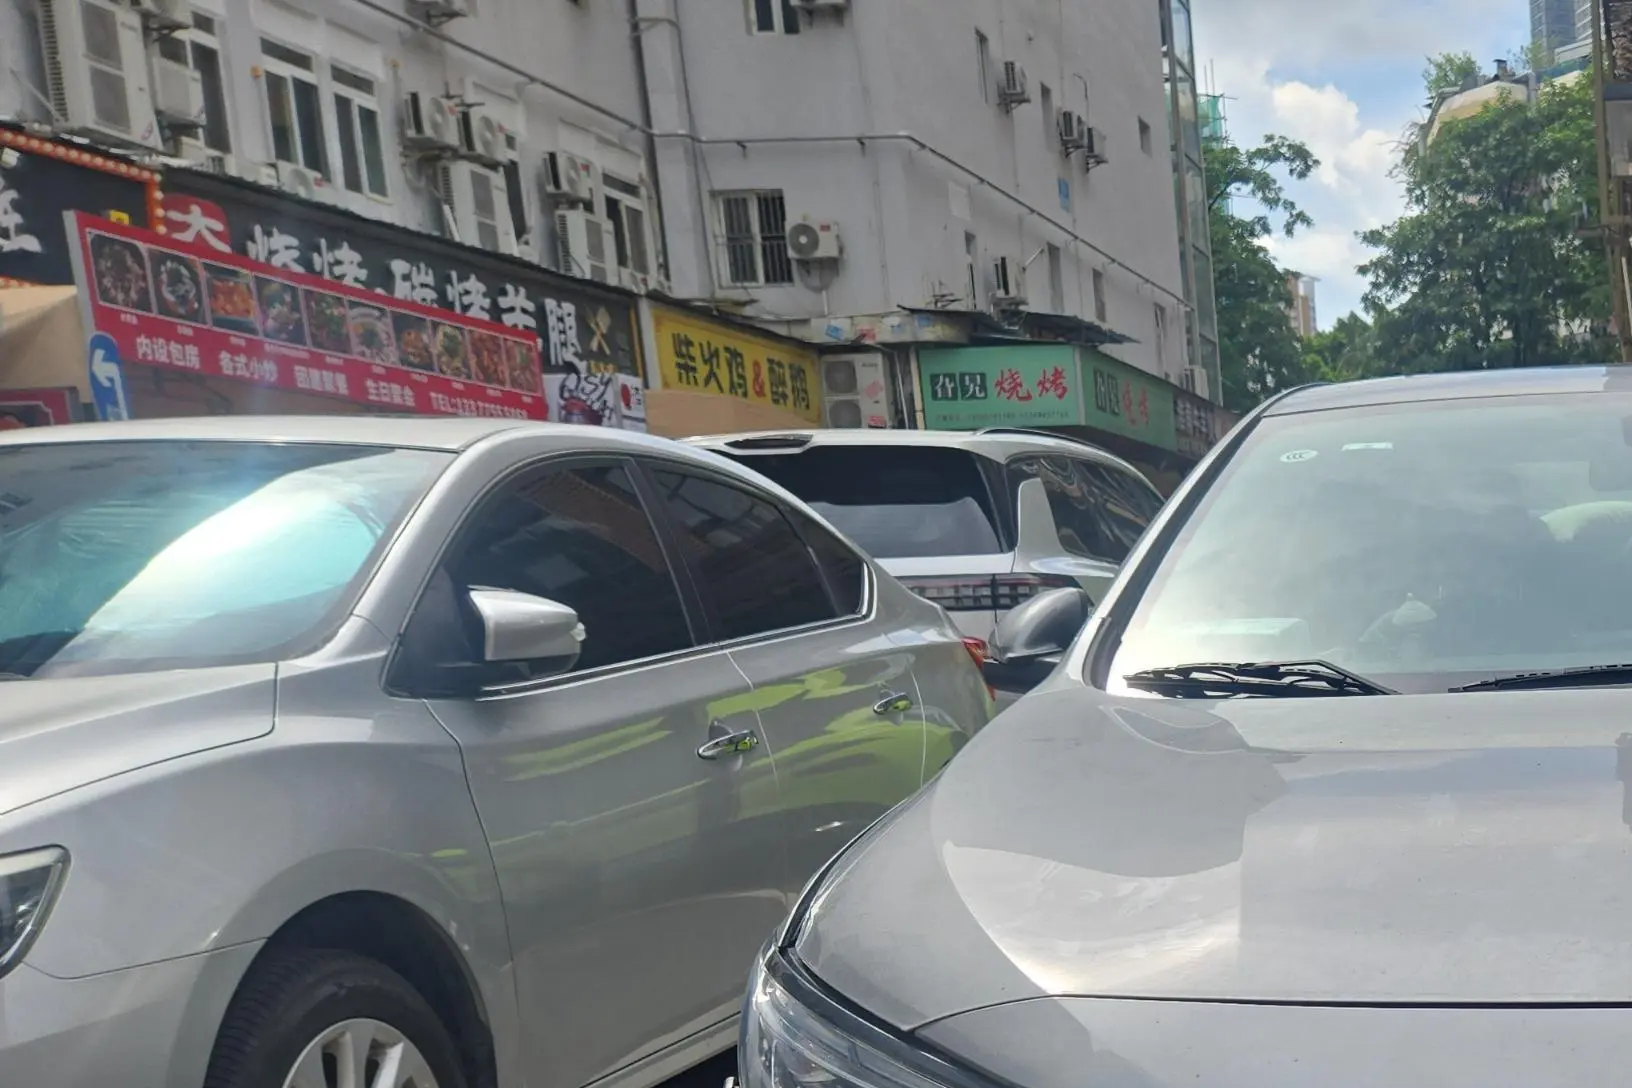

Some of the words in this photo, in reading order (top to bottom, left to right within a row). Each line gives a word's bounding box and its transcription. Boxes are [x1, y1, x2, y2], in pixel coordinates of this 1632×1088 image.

[136, 334, 200, 370] 内设包房
[219, 350, 278, 383] 各式小炒
